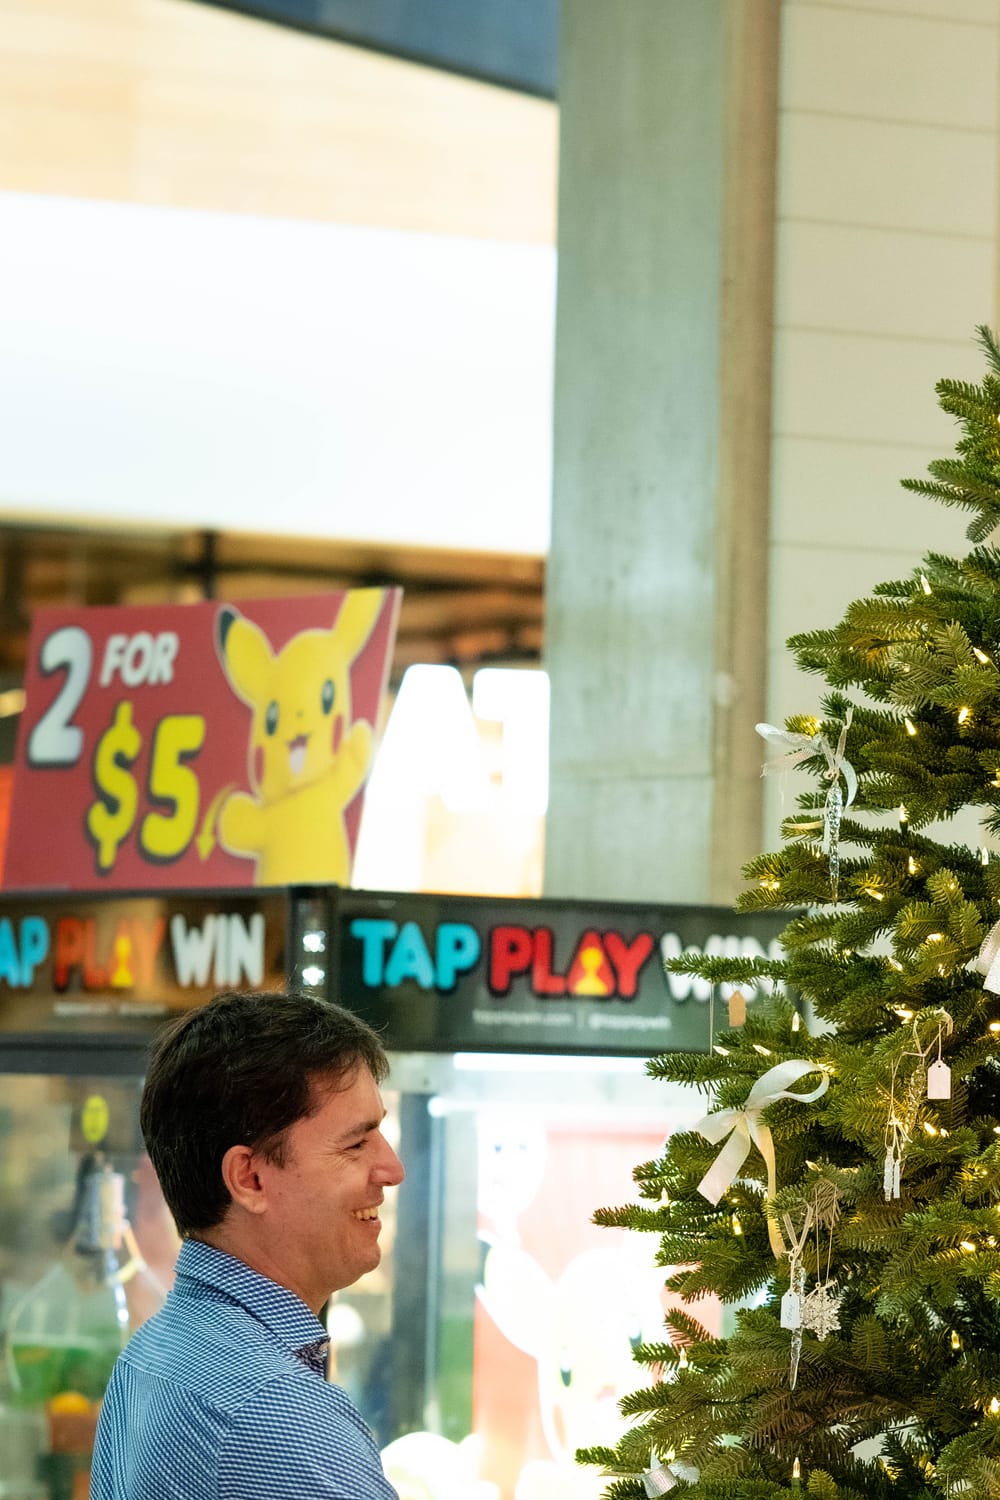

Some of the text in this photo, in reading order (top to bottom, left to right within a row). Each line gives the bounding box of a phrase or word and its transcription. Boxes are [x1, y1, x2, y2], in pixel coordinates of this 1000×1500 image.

[29, 626, 178, 763] 2 FOR
[87, 700, 206, 869] $5
[0, 912, 265, 989] AP PLAY WIN
[350, 918, 481, 990] TAP
[489, 925, 655, 998] PLAY
